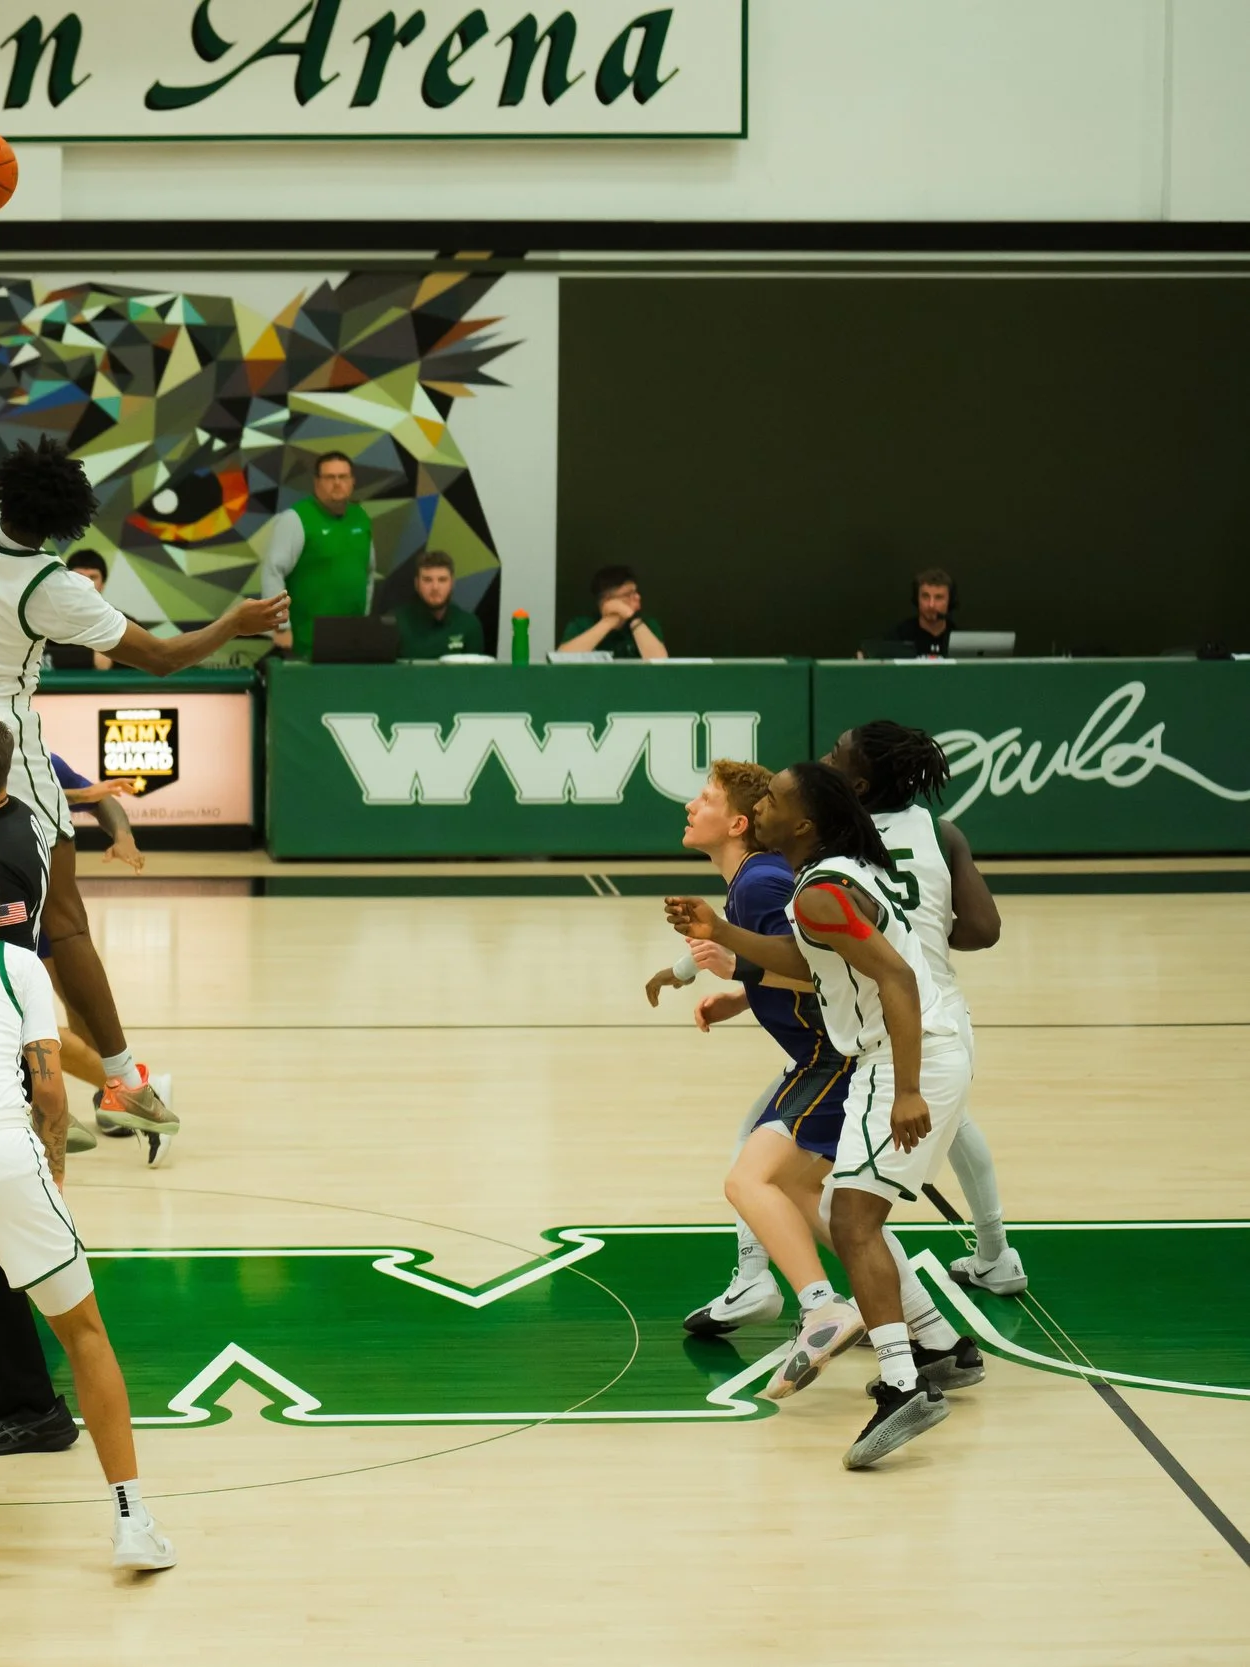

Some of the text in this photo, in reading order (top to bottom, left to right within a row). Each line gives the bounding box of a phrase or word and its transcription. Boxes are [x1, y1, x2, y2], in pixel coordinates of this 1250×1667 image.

[143, 0, 680, 111] Arena
[104, 723, 172, 742] ARMY
[104, 752, 174, 771] GUARD
[321, 711, 761, 806] WWU
[874, 848, 921, 911] 5
